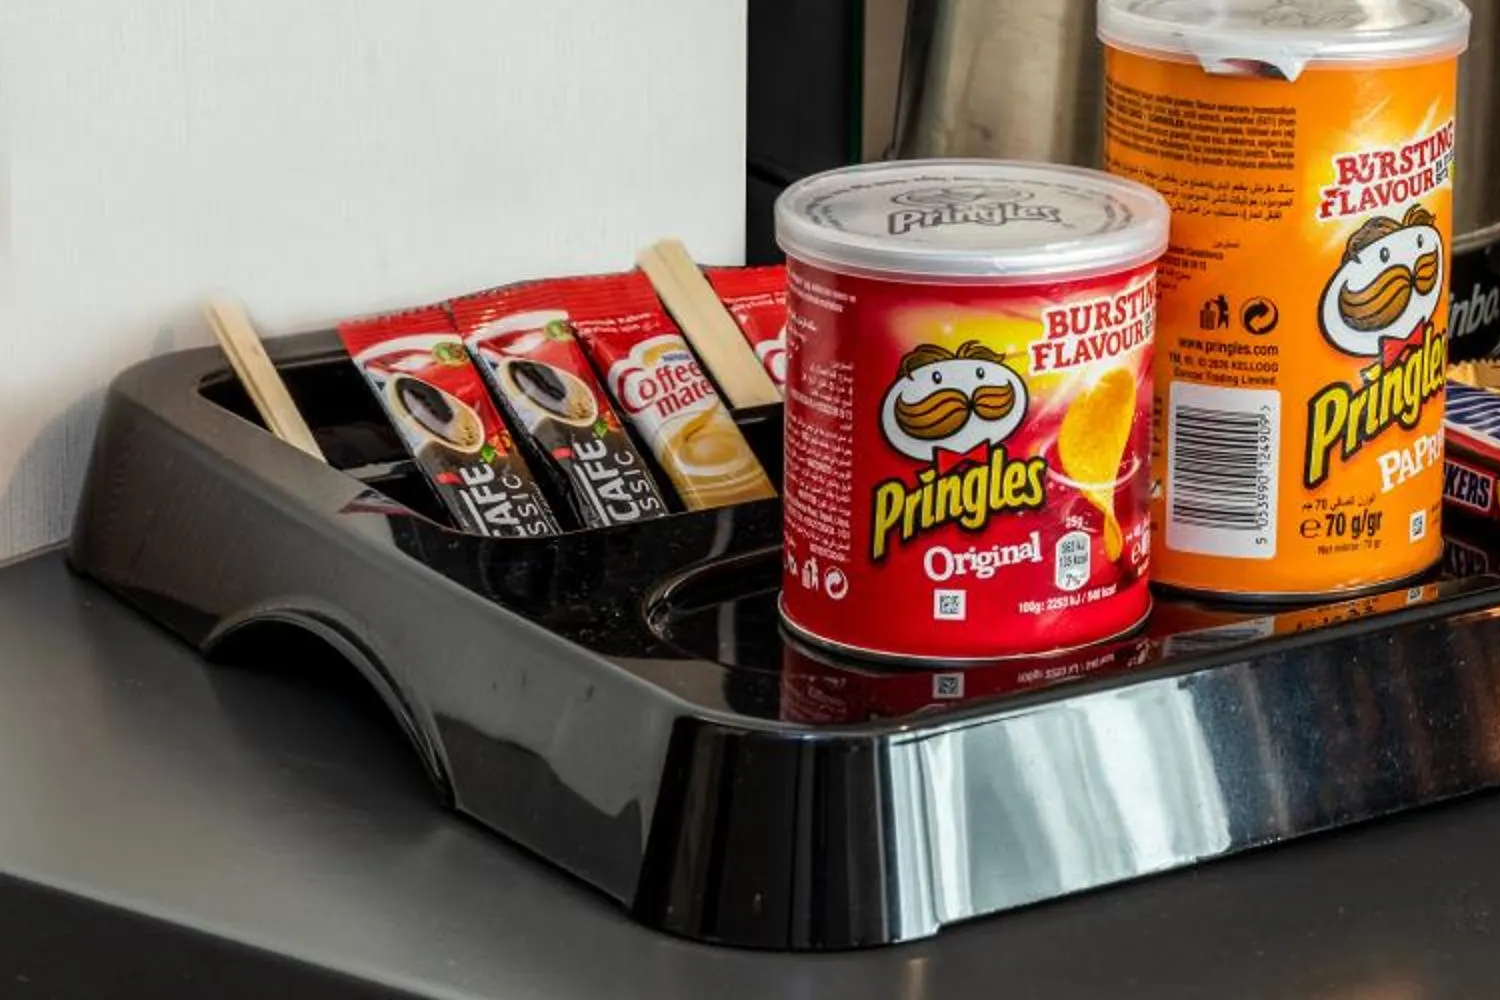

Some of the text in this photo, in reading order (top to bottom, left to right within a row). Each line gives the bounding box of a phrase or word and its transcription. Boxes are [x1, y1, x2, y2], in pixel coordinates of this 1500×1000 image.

[888, 201, 1063, 235] Pringles
[1320, 167, 1435, 219] FLAVOUR
[1045, 279, 1155, 340] BURSTIN
[1449, 283, 1499, 339] nbo
[1031, 319, 1145, 372] FLAVOUR
[617, 361, 703, 415] Coffee
[655, 379, 715, 419] mate
[873, 446, 1047, 561] Pringles
[1325, 512, 1347, 537] 70
[1351, 509, 1383, 540] g/gr
[923, 531, 1043, 581] Original
